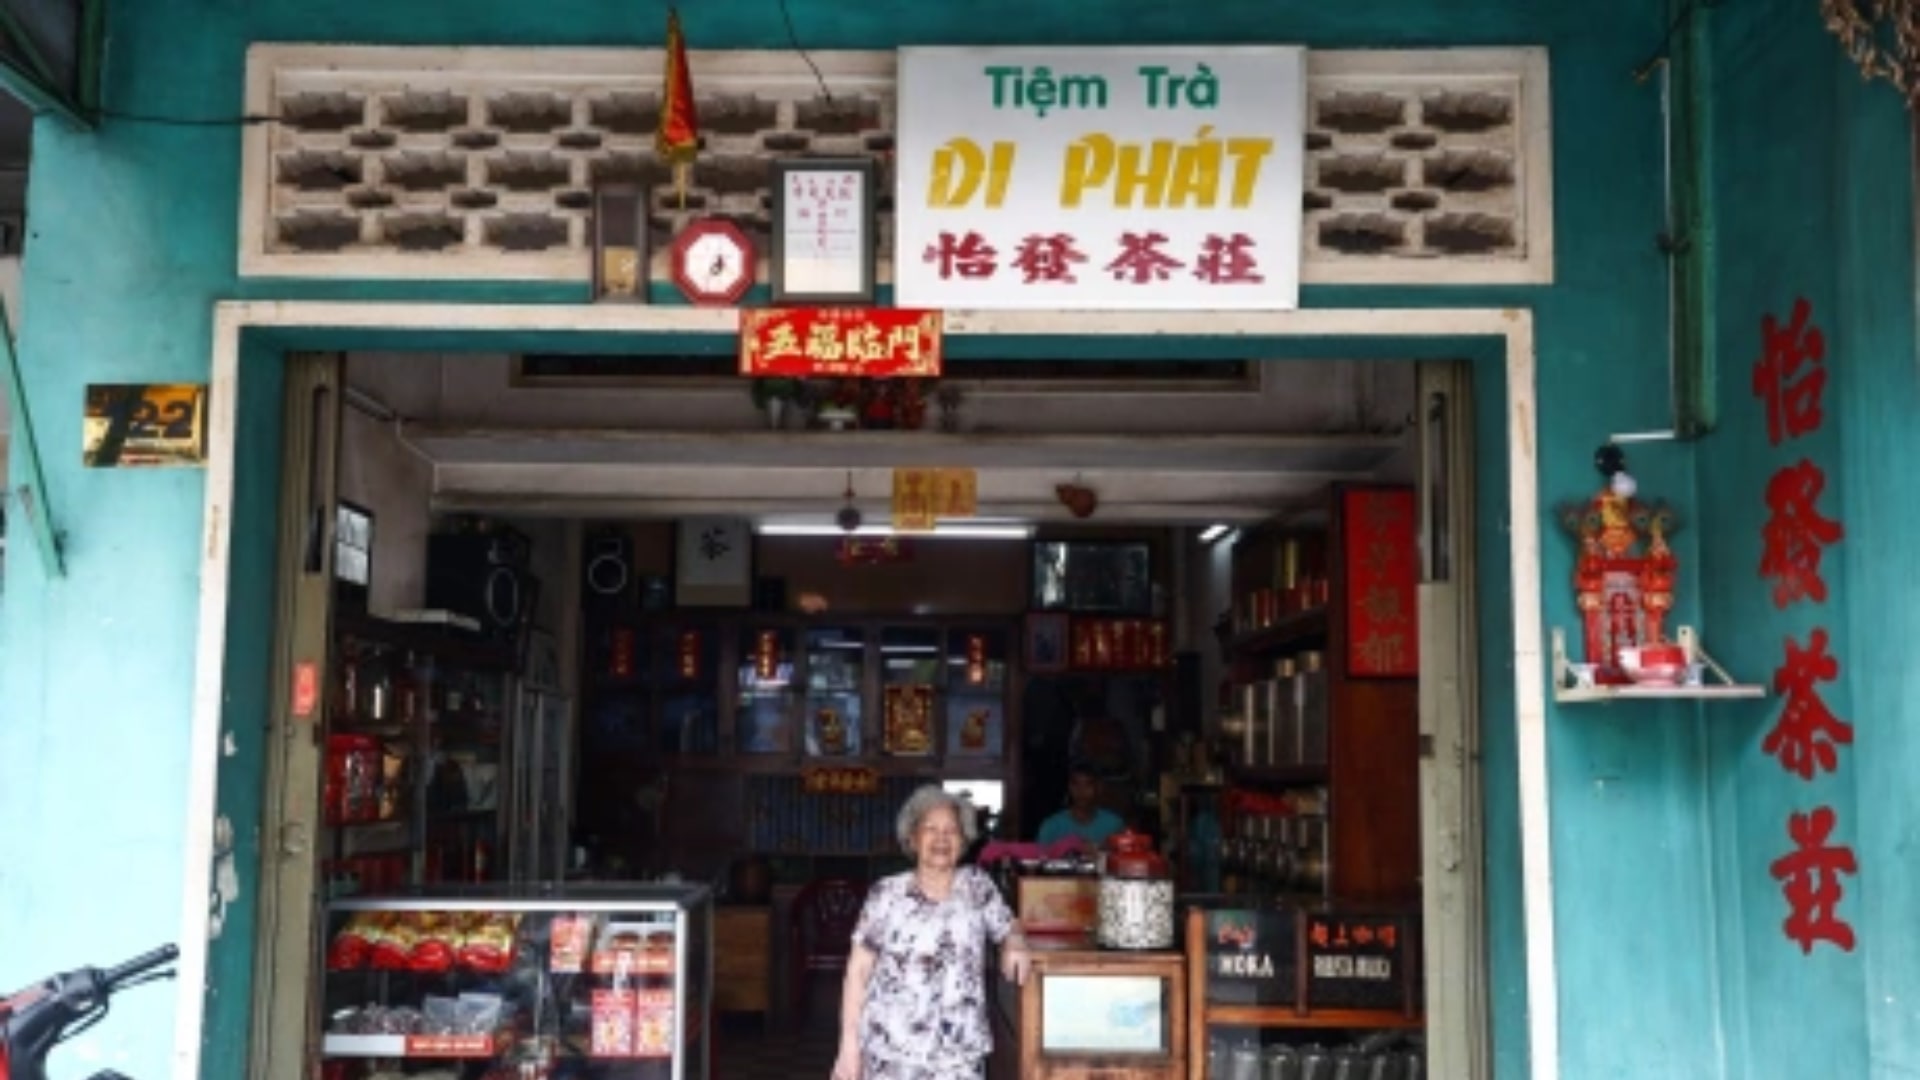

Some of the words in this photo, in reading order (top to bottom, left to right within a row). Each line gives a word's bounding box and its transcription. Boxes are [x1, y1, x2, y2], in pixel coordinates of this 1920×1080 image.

[985, 66, 1110, 117] Tiệm
[1138, 63, 1220, 109] Trà
[927, 136, 1016, 209] DI
[1060, 125, 1274, 209] PHÁT
[923, 231, 1264, 285] 怡發茶莊
[1752, 297, 1859, 953] 怡發茶莊
